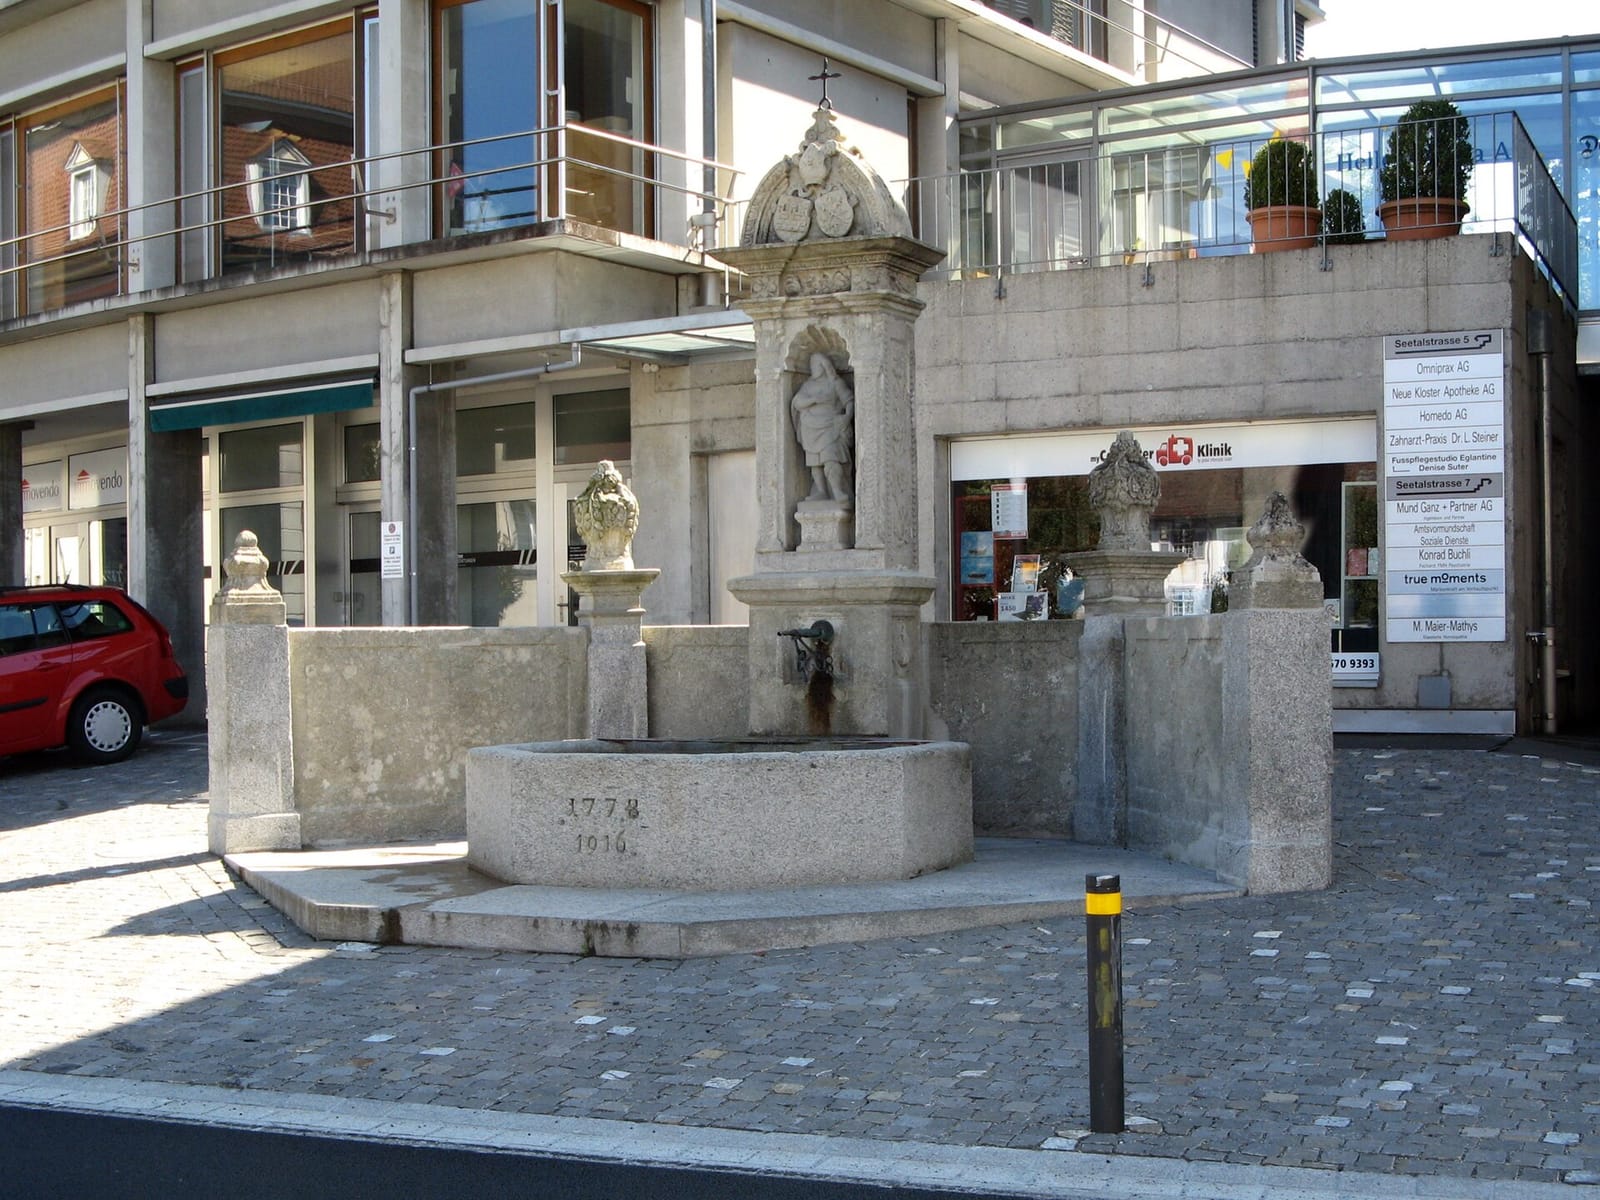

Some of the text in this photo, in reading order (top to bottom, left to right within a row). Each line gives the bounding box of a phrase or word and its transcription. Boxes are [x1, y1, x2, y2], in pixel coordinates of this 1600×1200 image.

[1395, 335, 1470, 348] Seetalstrasse 5
[1416, 360, 1470, 375] Omniprax AG
[1392, 382, 1495, 399] Neue Kloster Apotheke AG
[1419, 408, 1468, 422] Homedo AG
[1389, 432, 1448, 447] Zahnarzt-Praxis
[1451, 432, 1464, 444] Dr.
[1472, 431, 1499, 443] Steiner
[1197, 442, 1232, 457] Klinik
[1391, 453, 1497, 465] Fusspflegestudio Eglantine
[1418, 463, 1469, 472] Denise Suter
[1395, 478, 1471, 490] Seetalstrasse 7
[1396, 502, 1419, 513] Mund
[1420, 501, 1440, 513] Ganz
[1449, 500, 1478, 512] Partner
[1480, 499, 1493, 511] AG
[1413, 523, 1476, 534] Amtsvormundschaft
[1420, 535, 1469, 546] Soziale Dienste
[1418, 547, 1471, 561] Konrad Buchli
[1404, 573, 1487, 584] true moments
[1412, 620, 1478, 633] M. Maier-Mathys
[1349, 658, 1375, 669] 9393
[567, 798, 640, 819] 1778
